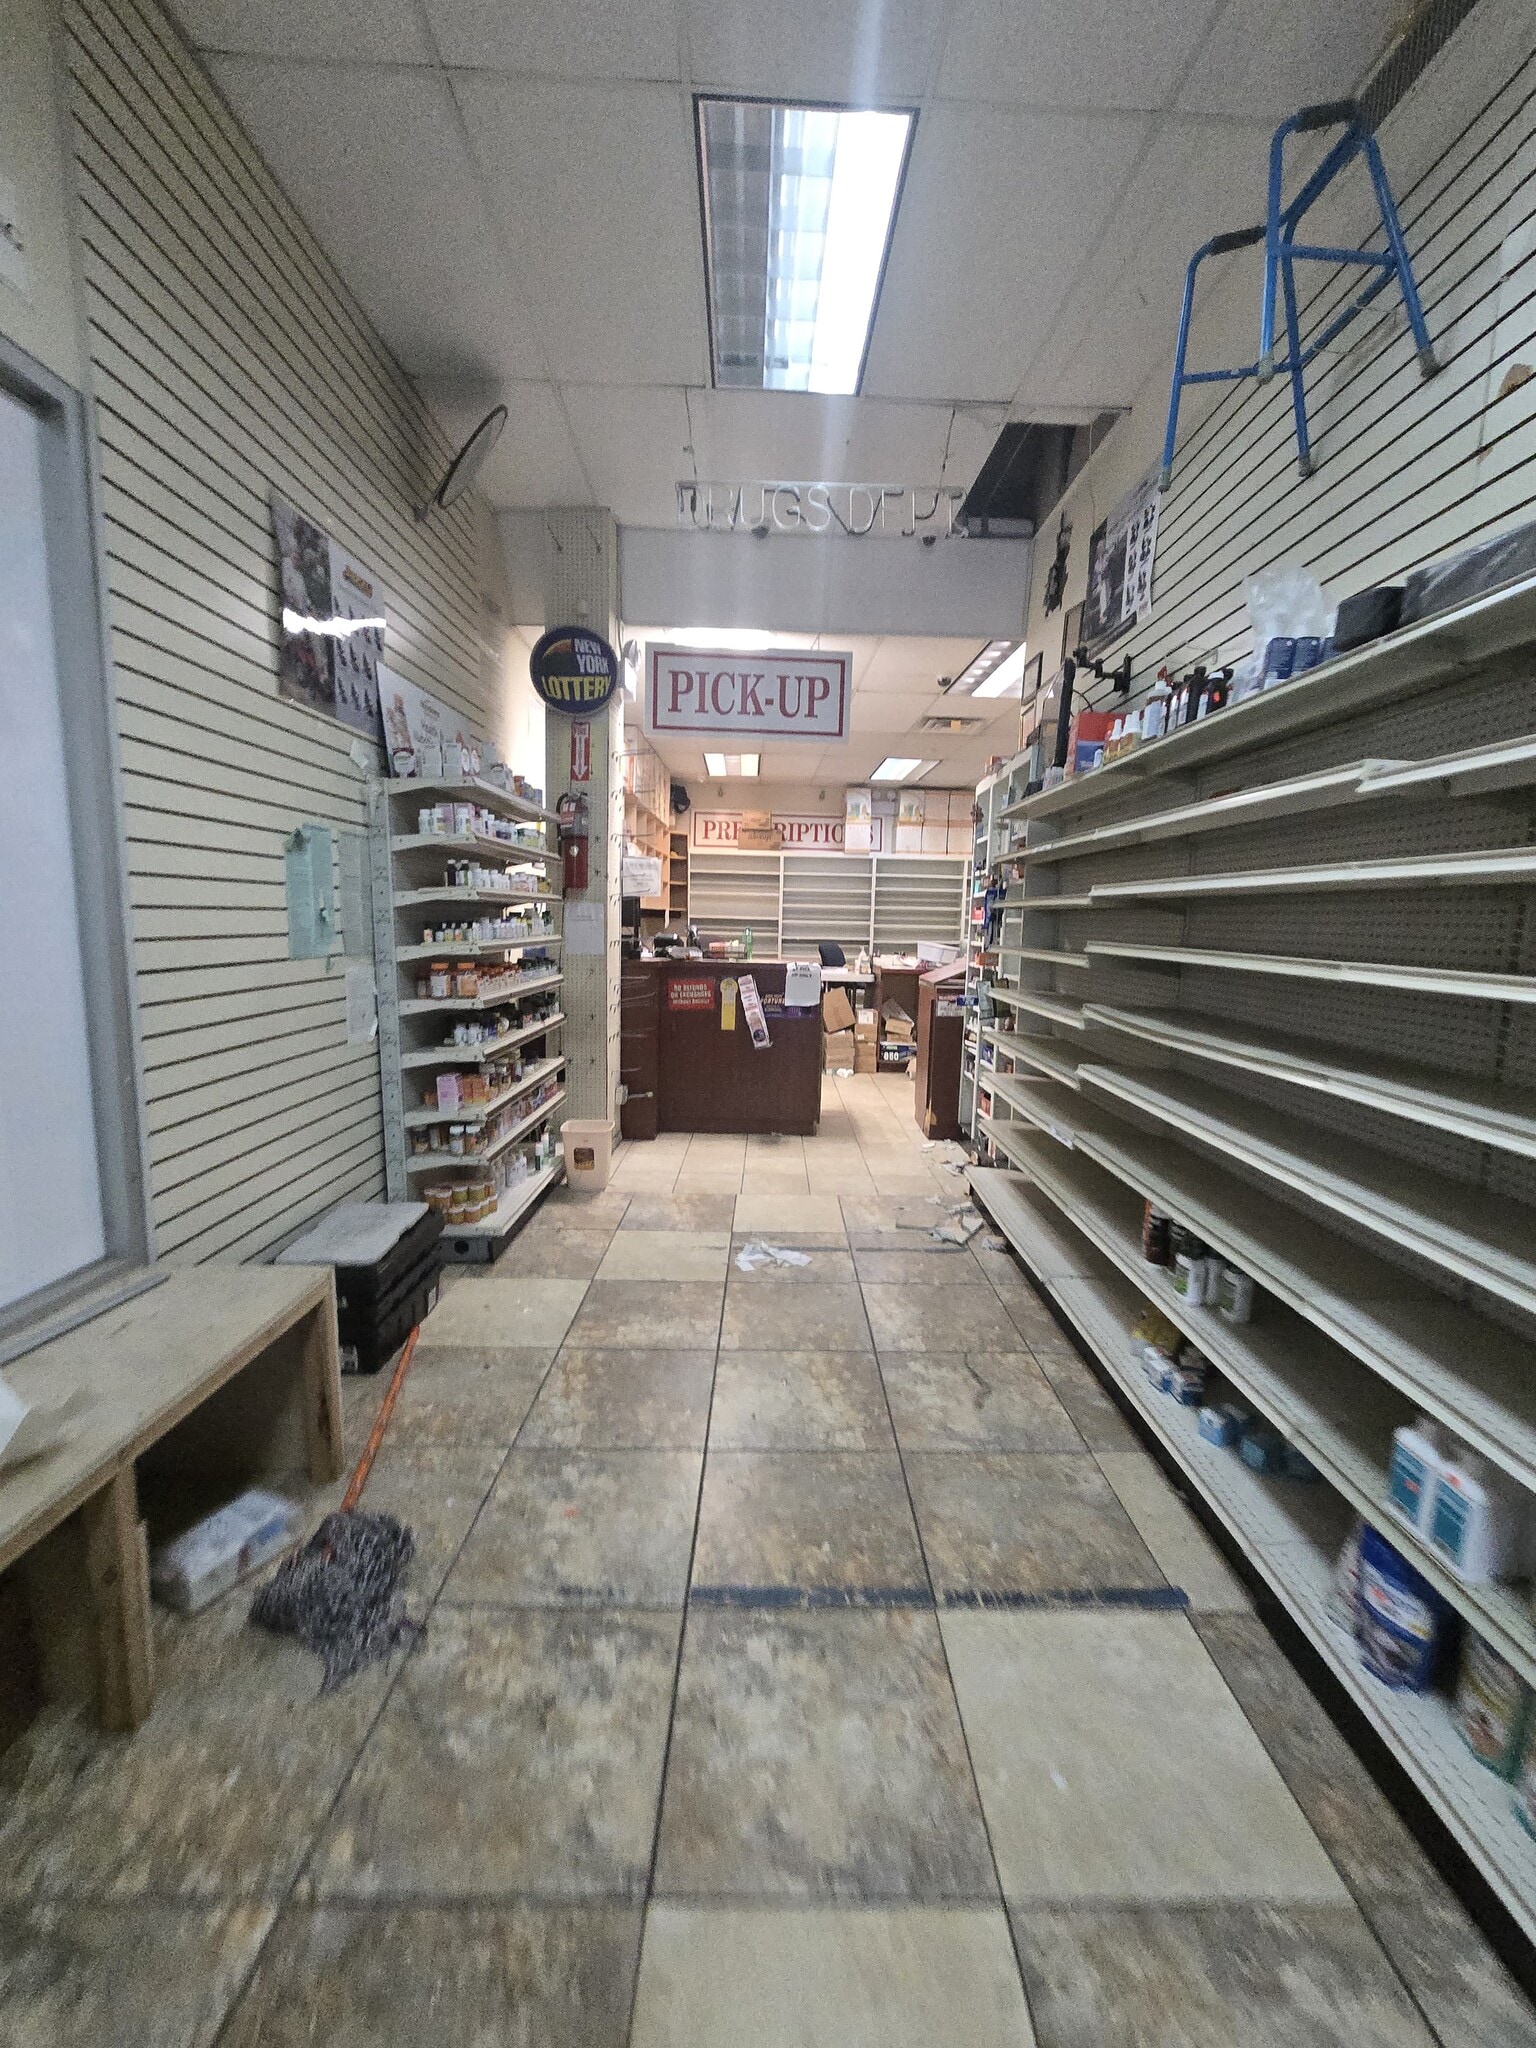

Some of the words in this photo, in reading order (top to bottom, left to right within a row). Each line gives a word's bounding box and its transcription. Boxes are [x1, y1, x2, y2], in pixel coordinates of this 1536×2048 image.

[573, 638, 602, 656] NEW
[576, 654, 610, 674] YORK
[541, 675, 612, 701] LOTTERY
[667, 669, 831, 719] PICK-UP
